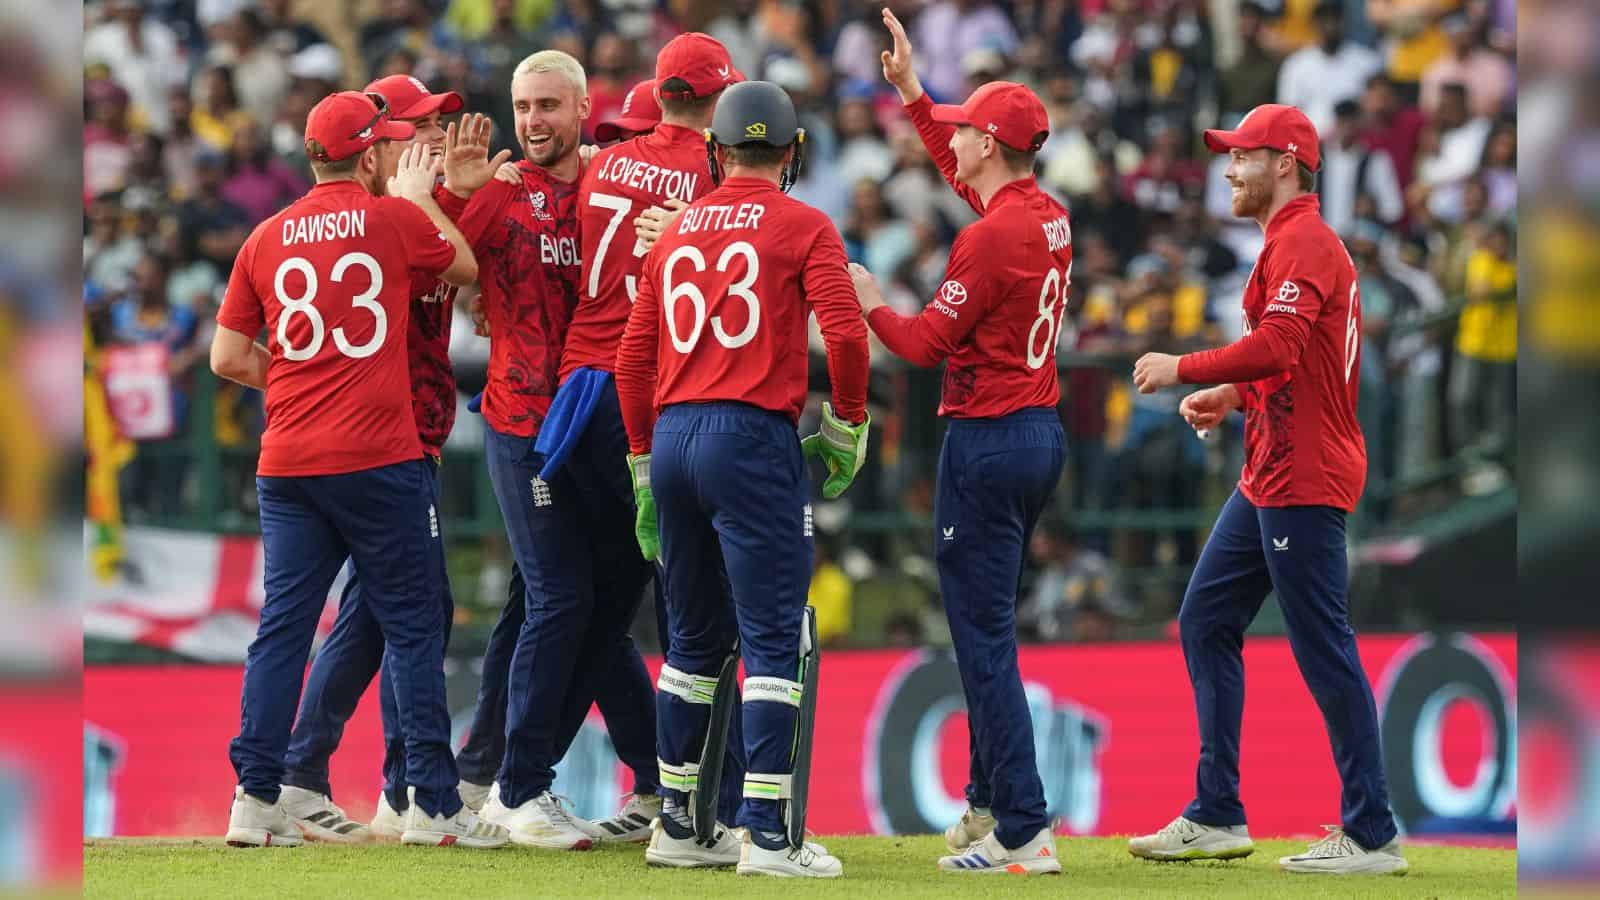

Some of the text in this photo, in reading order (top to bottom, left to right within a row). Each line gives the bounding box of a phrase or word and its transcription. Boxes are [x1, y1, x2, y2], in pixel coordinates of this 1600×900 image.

[598, 153, 698, 203] J.OVERTON
[282, 209, 366, 247] DAWSON
[678, 203, 765, 235] BUTTLER
[274, 252, 387, 361] 83
[663, 241, 760, 354] 63
[926, 299, 958, 320] OYOTA
[1266, 303, 1297, 315] OYOTA
